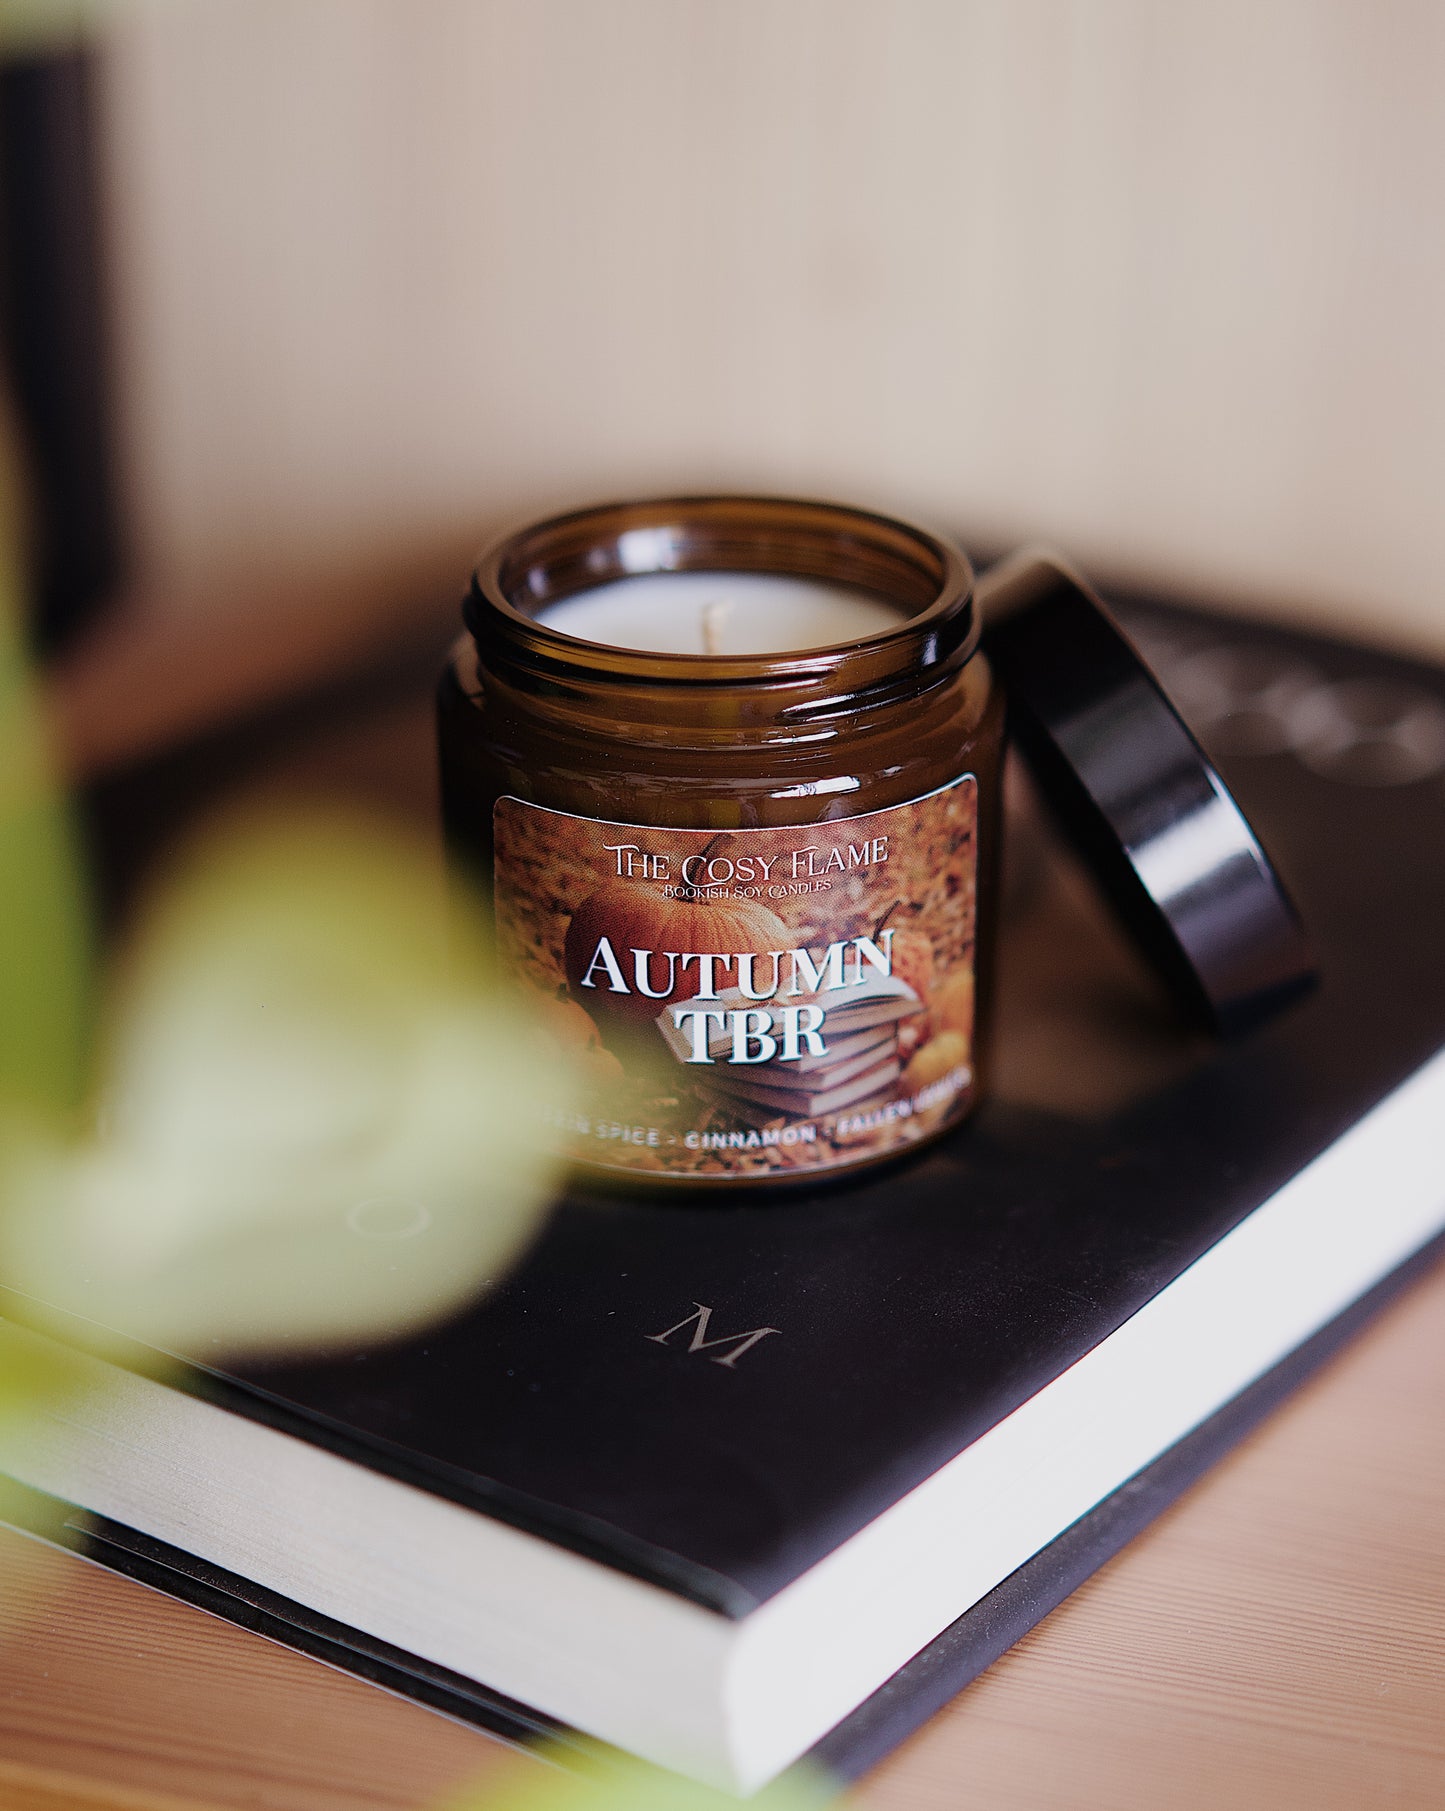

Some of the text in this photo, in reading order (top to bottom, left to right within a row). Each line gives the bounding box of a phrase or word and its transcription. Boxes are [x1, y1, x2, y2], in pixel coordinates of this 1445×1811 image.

[602, 835, 890, 888] THE COSY FLAME
[662, 878, 833, 899] BOOKISH SOY CANDLES
[580, 928, 896, 1001] AUTUMN
[674, 1003, 831, 1065] TBR
[595, 1119, 661, 1148] SPICE
[684, 1123, 818, 1150] CINNAMON
[836, 1098, 913, 1136] FALLEN
[644, 1301, 784, 1370] M
